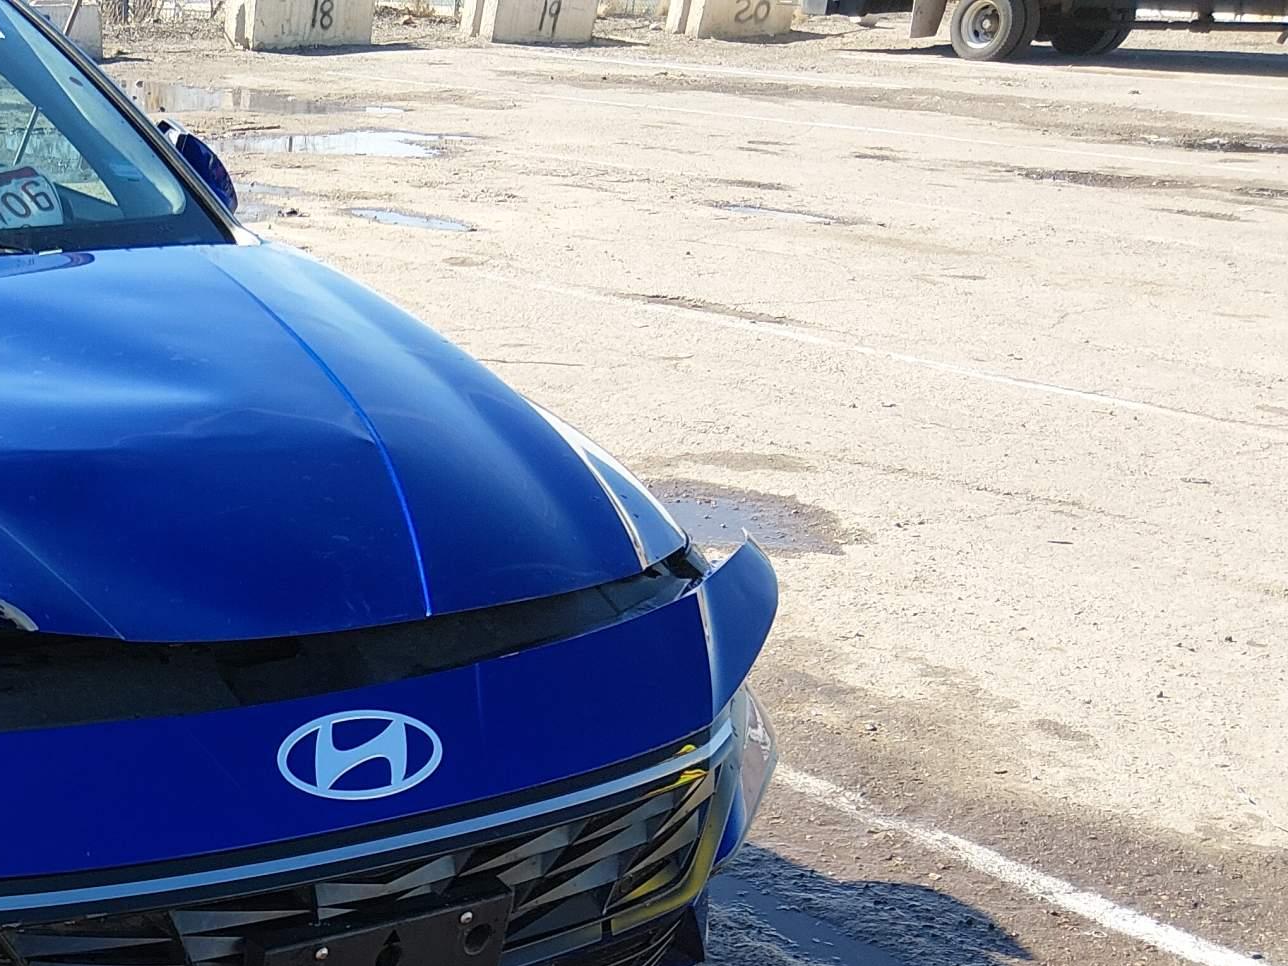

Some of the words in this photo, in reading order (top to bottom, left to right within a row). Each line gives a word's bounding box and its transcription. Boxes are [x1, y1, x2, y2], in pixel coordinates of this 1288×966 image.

[311, 0, 334, 30] 18
[538, 0, 562, 36] 19
[734, 0, 771, 24] 20
